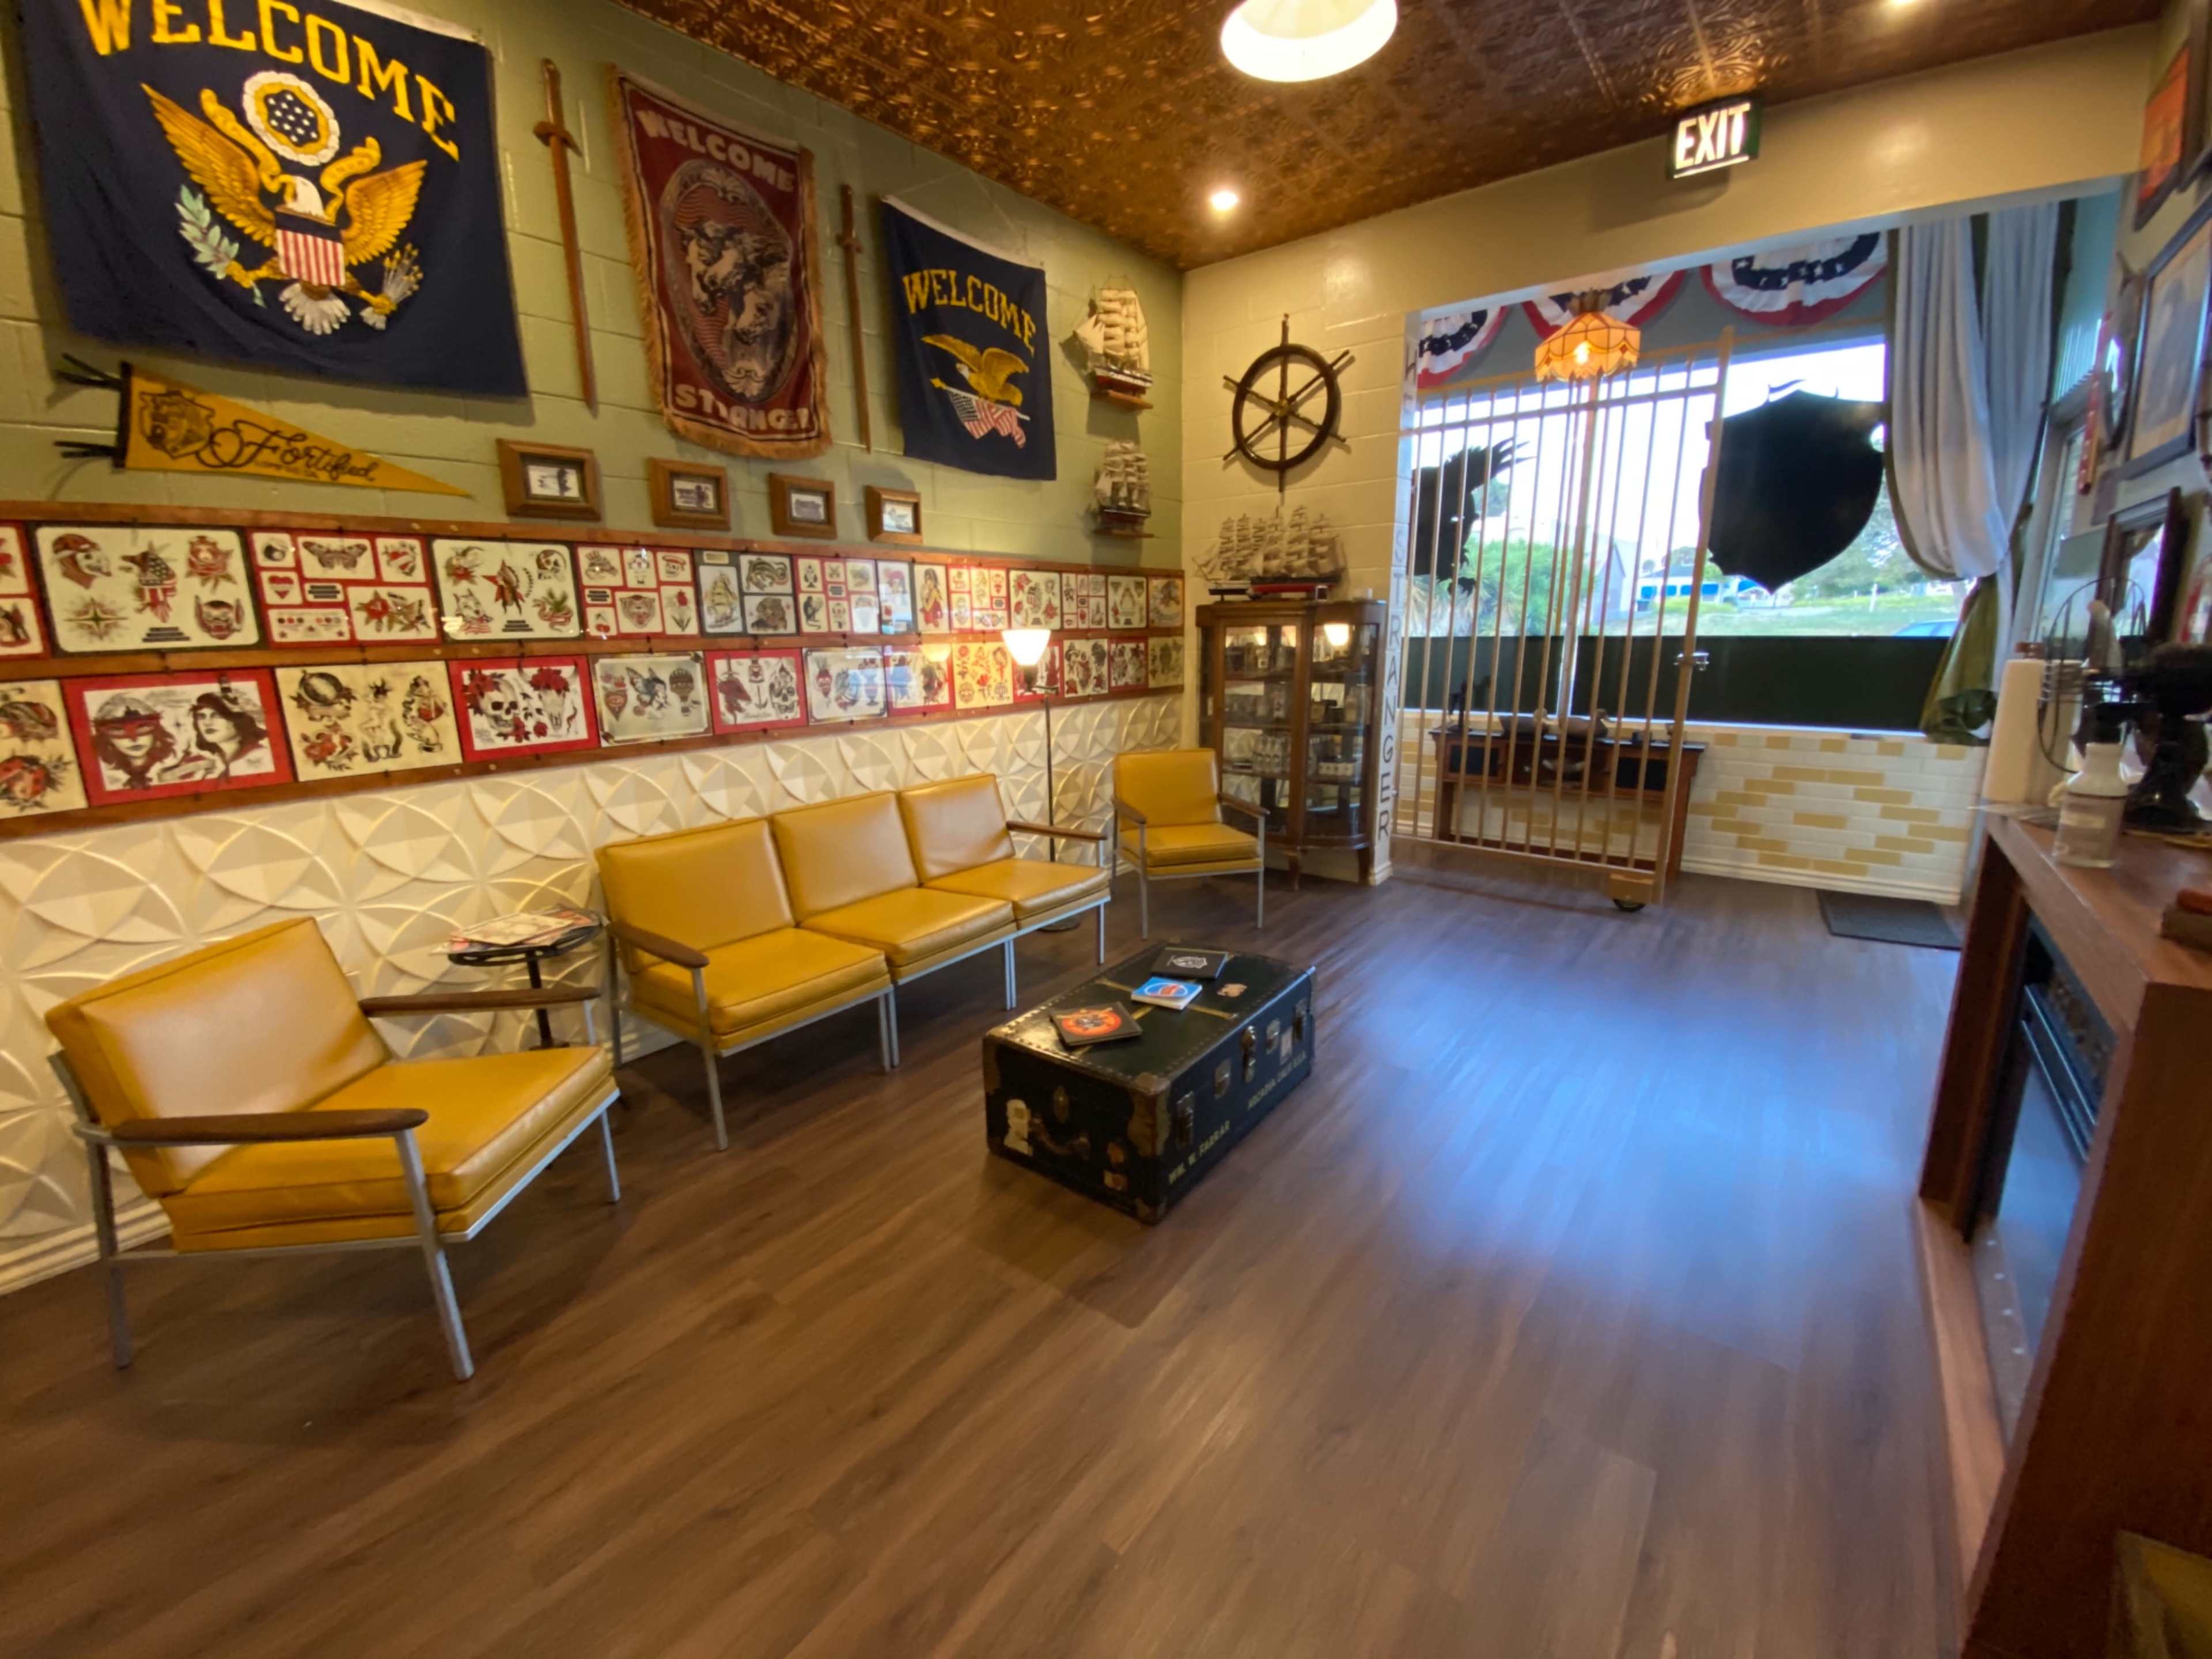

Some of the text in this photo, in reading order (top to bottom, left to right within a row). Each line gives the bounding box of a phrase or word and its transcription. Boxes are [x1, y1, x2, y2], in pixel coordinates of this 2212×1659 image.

[78, 0, 460, 162] WELCOME
[635, 110, 796, 192] WELCOME
[1675, 102, 1751, 169] EXIT
[903, 268, 1036, 358] WELCOME
[1377, 528, 1404, 840] STRANGER
